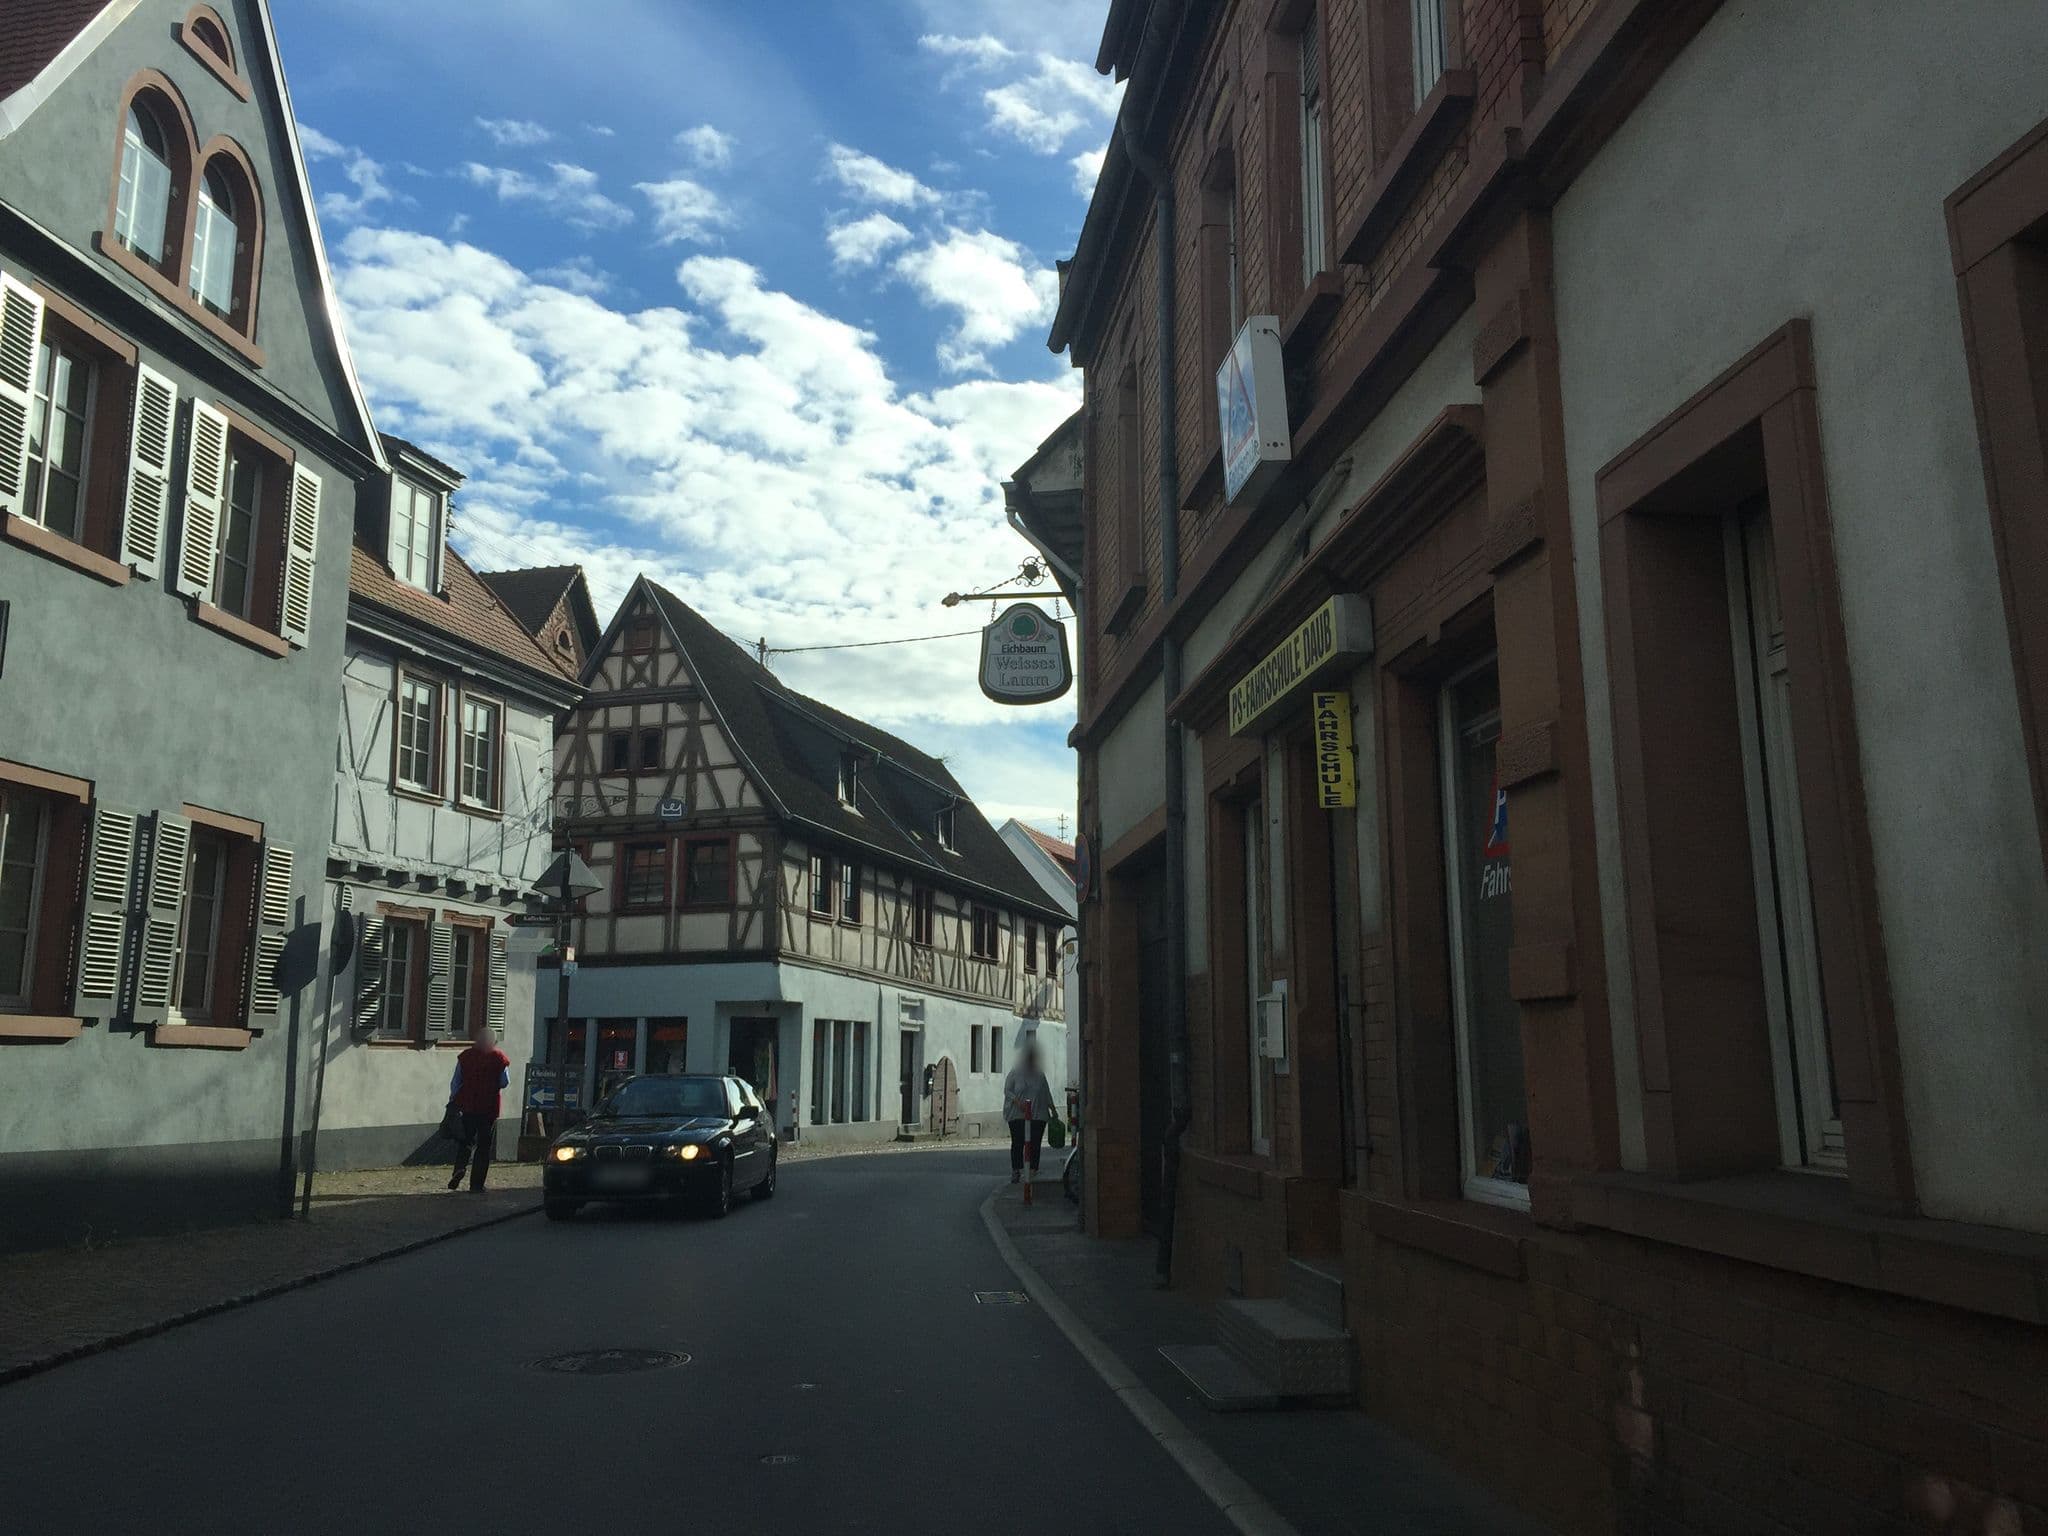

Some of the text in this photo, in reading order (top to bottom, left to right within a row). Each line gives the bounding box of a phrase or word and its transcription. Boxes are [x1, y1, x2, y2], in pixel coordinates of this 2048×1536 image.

[1001, 643, 1047, 654] Eichbaum
[996, 656, 1056, 671] Weisses
[1231, 608, 1333, 729] PS-FAHRSCHULE DAUB
[999, 672, 1050, 687] Lamm
[1317, 695, 1342, 806] FAHRSCHULE
